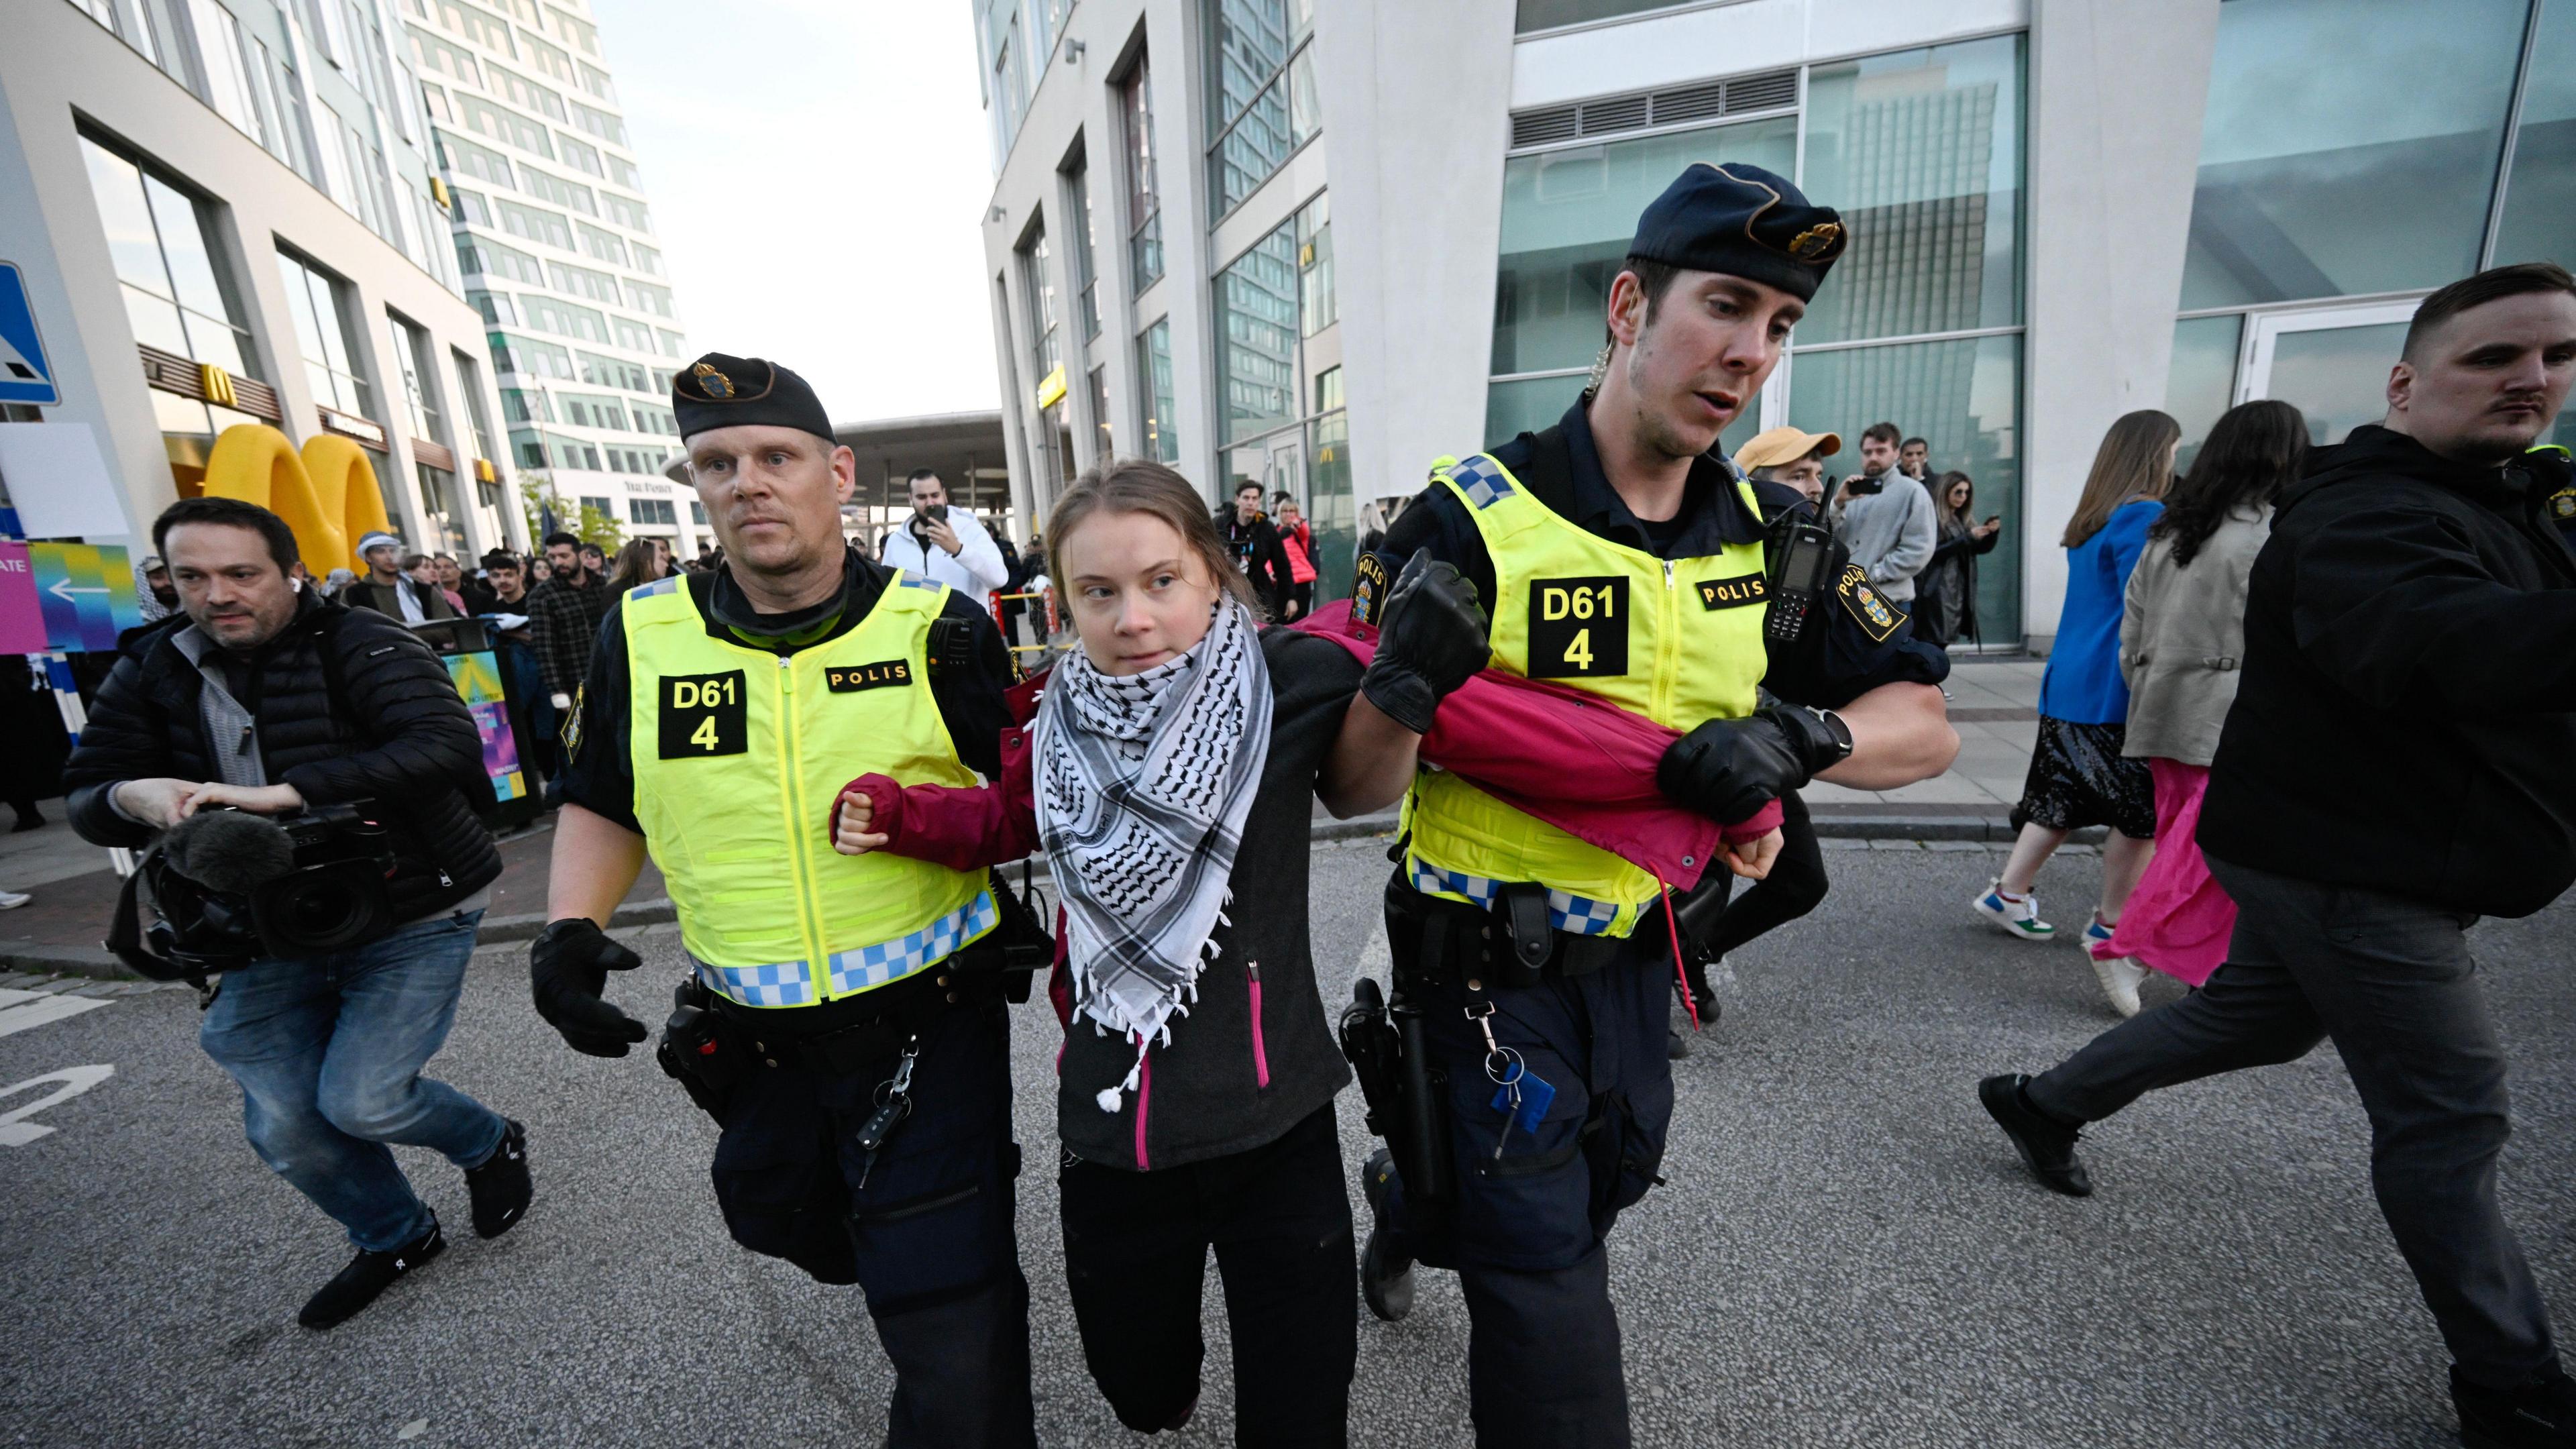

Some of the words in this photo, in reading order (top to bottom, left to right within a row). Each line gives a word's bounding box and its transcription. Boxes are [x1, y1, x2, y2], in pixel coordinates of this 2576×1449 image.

[0, 559, 26, 573] ATE
[1358, 558, 1384, 586] POLIS
[1703, 580, 1764, 602] POLIS
[1839, 570, 1867, 596] POLIS
[1544, 584, 1613, 621] D61
[1564, 628, 1594, 670] 4
[830, 665, 906, 686] POLIS
[674, 677, 735, 709] D61
[690, 715, 719, 751] 4
